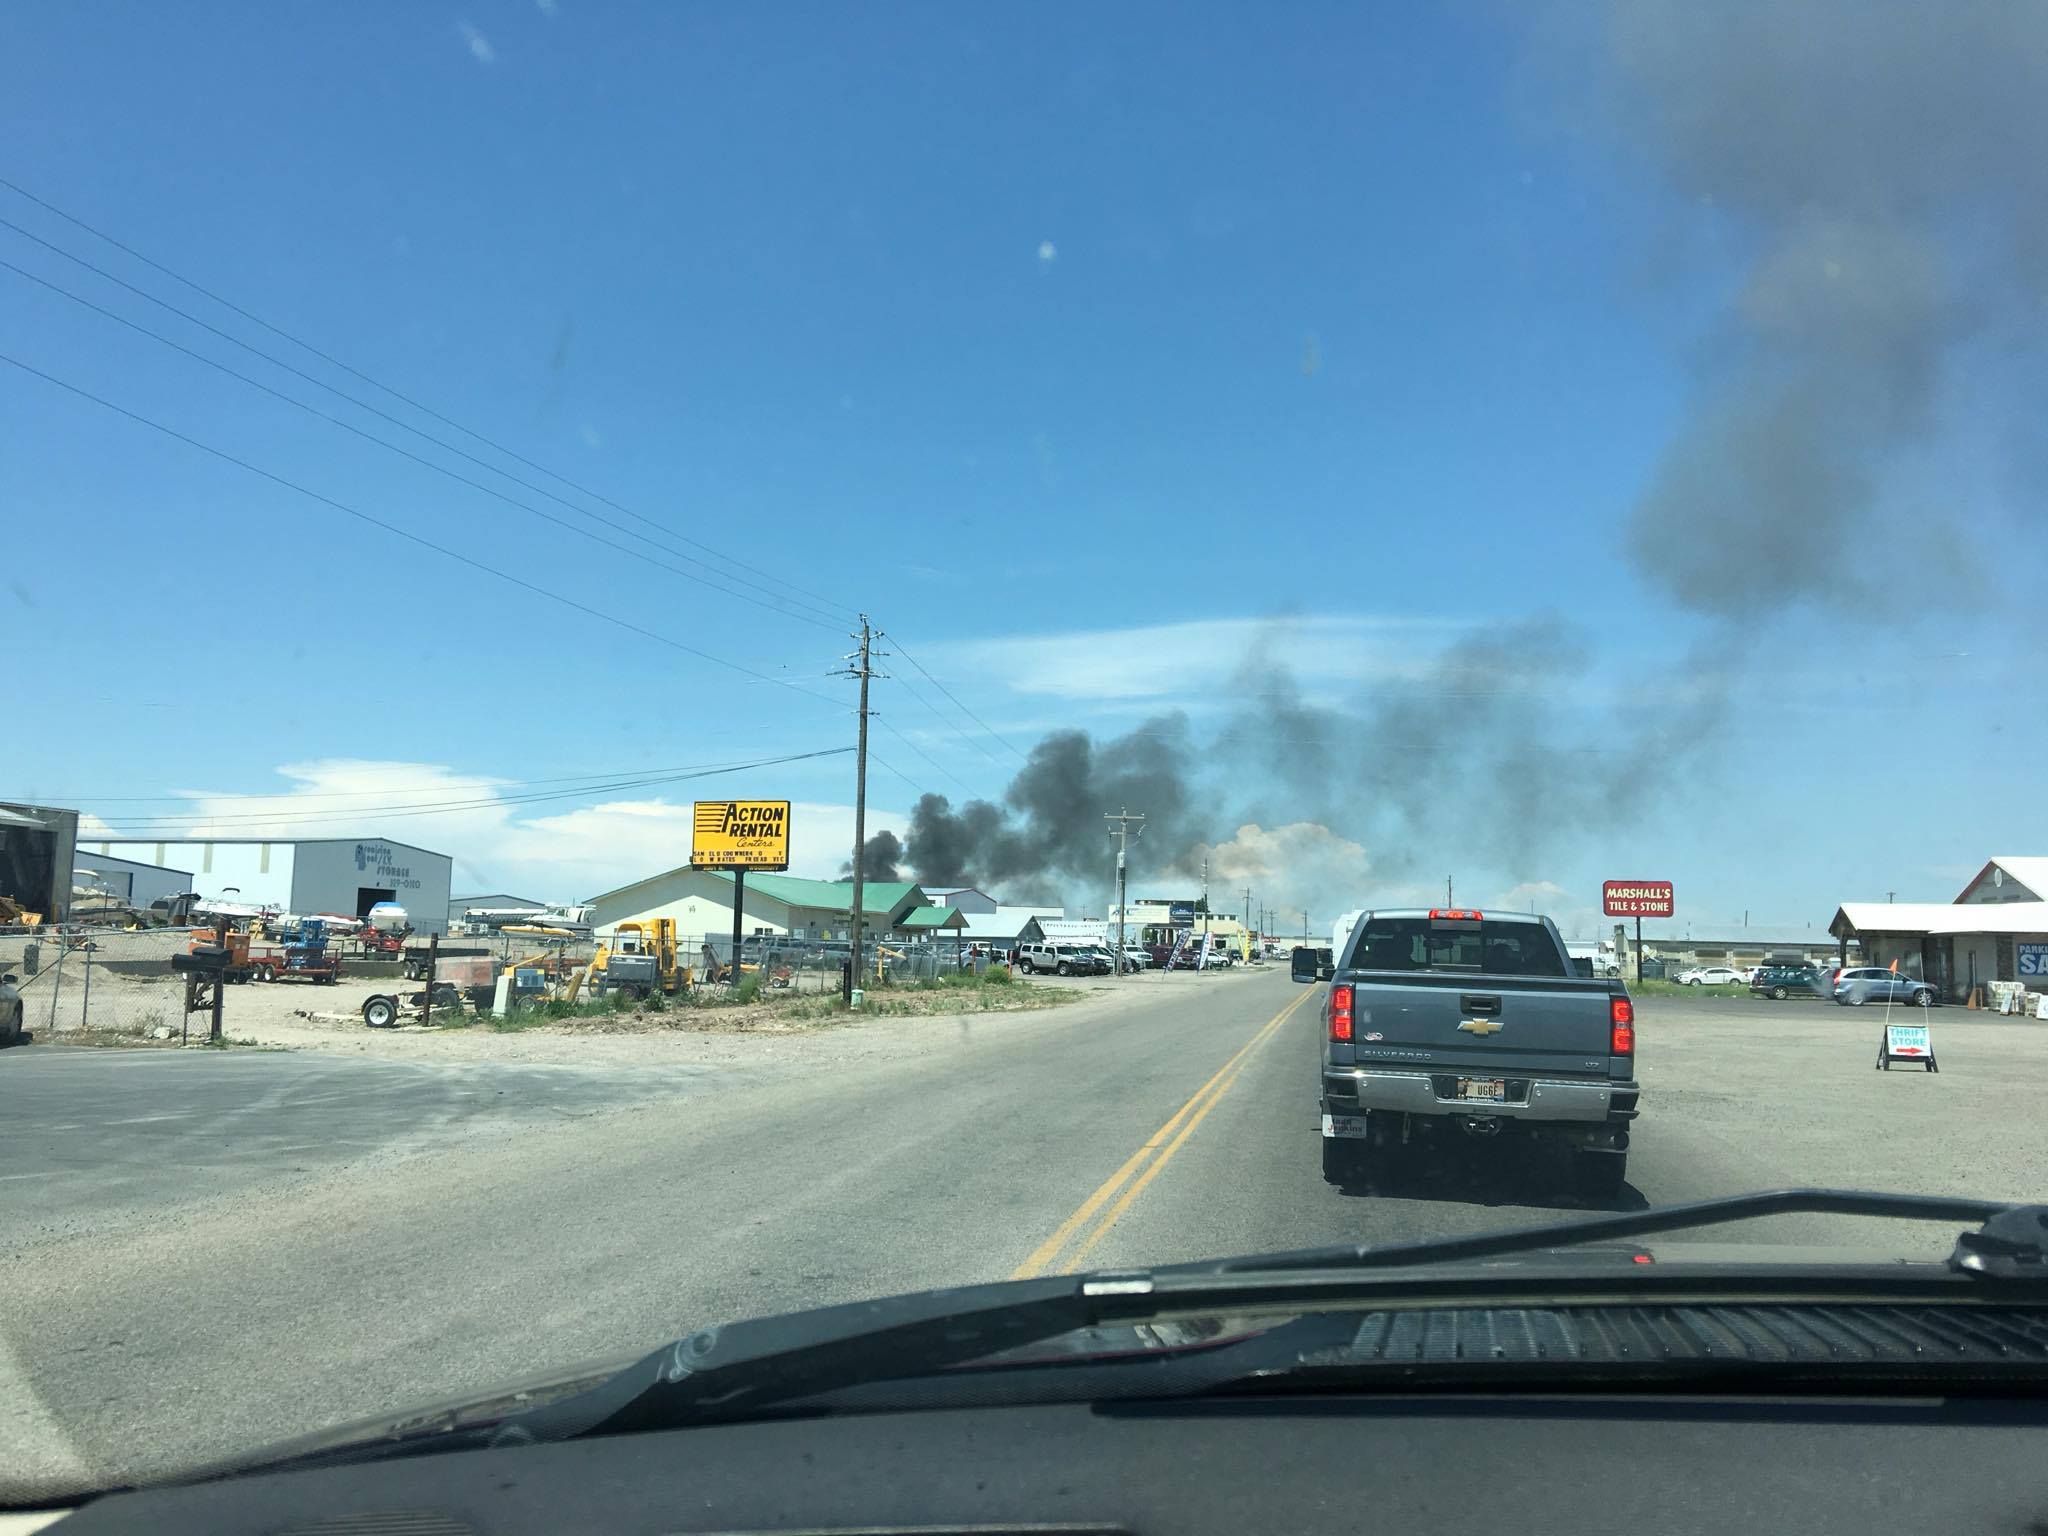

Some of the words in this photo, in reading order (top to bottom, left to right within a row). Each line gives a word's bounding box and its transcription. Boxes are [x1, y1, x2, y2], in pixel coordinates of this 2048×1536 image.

[721, 804, 784, 833] ACTION
[729, 823, 782, 837] RENTAL
[1606, 888, 1671, 899] MARSHALL'S
[1609, 901, 1628, 911] TILE
[1630, 901, 1637, 911] &
[1640, 902, 1669, 912] STONE
[1889, 1027, 1927, 1037] THRIFT
[1891, 1037, 1926, 1046] STORE
[1364, 1050, 1432, 1060] SILVERADO
